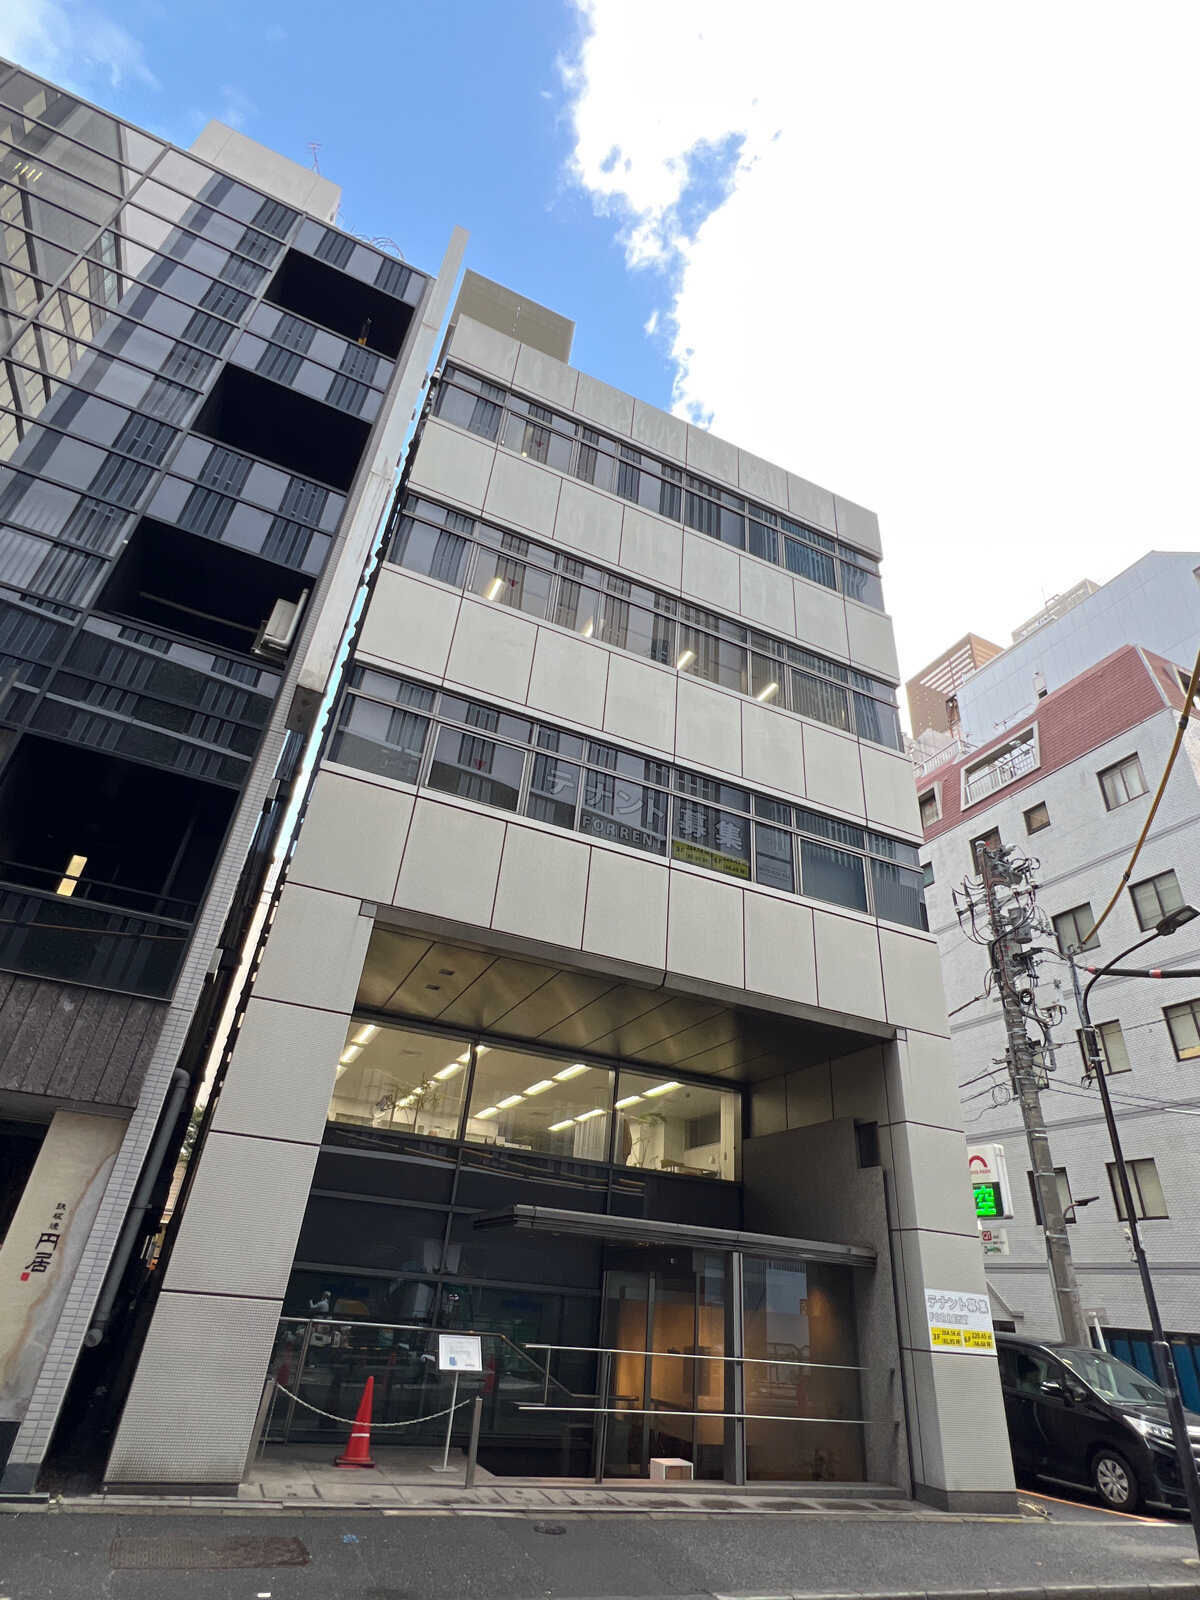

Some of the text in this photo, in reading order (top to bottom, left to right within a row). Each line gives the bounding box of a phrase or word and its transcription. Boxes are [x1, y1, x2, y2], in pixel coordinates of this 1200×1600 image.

[547, 769, 743, 850] テナント募集
[973, 1184, 997, 1216] 空
